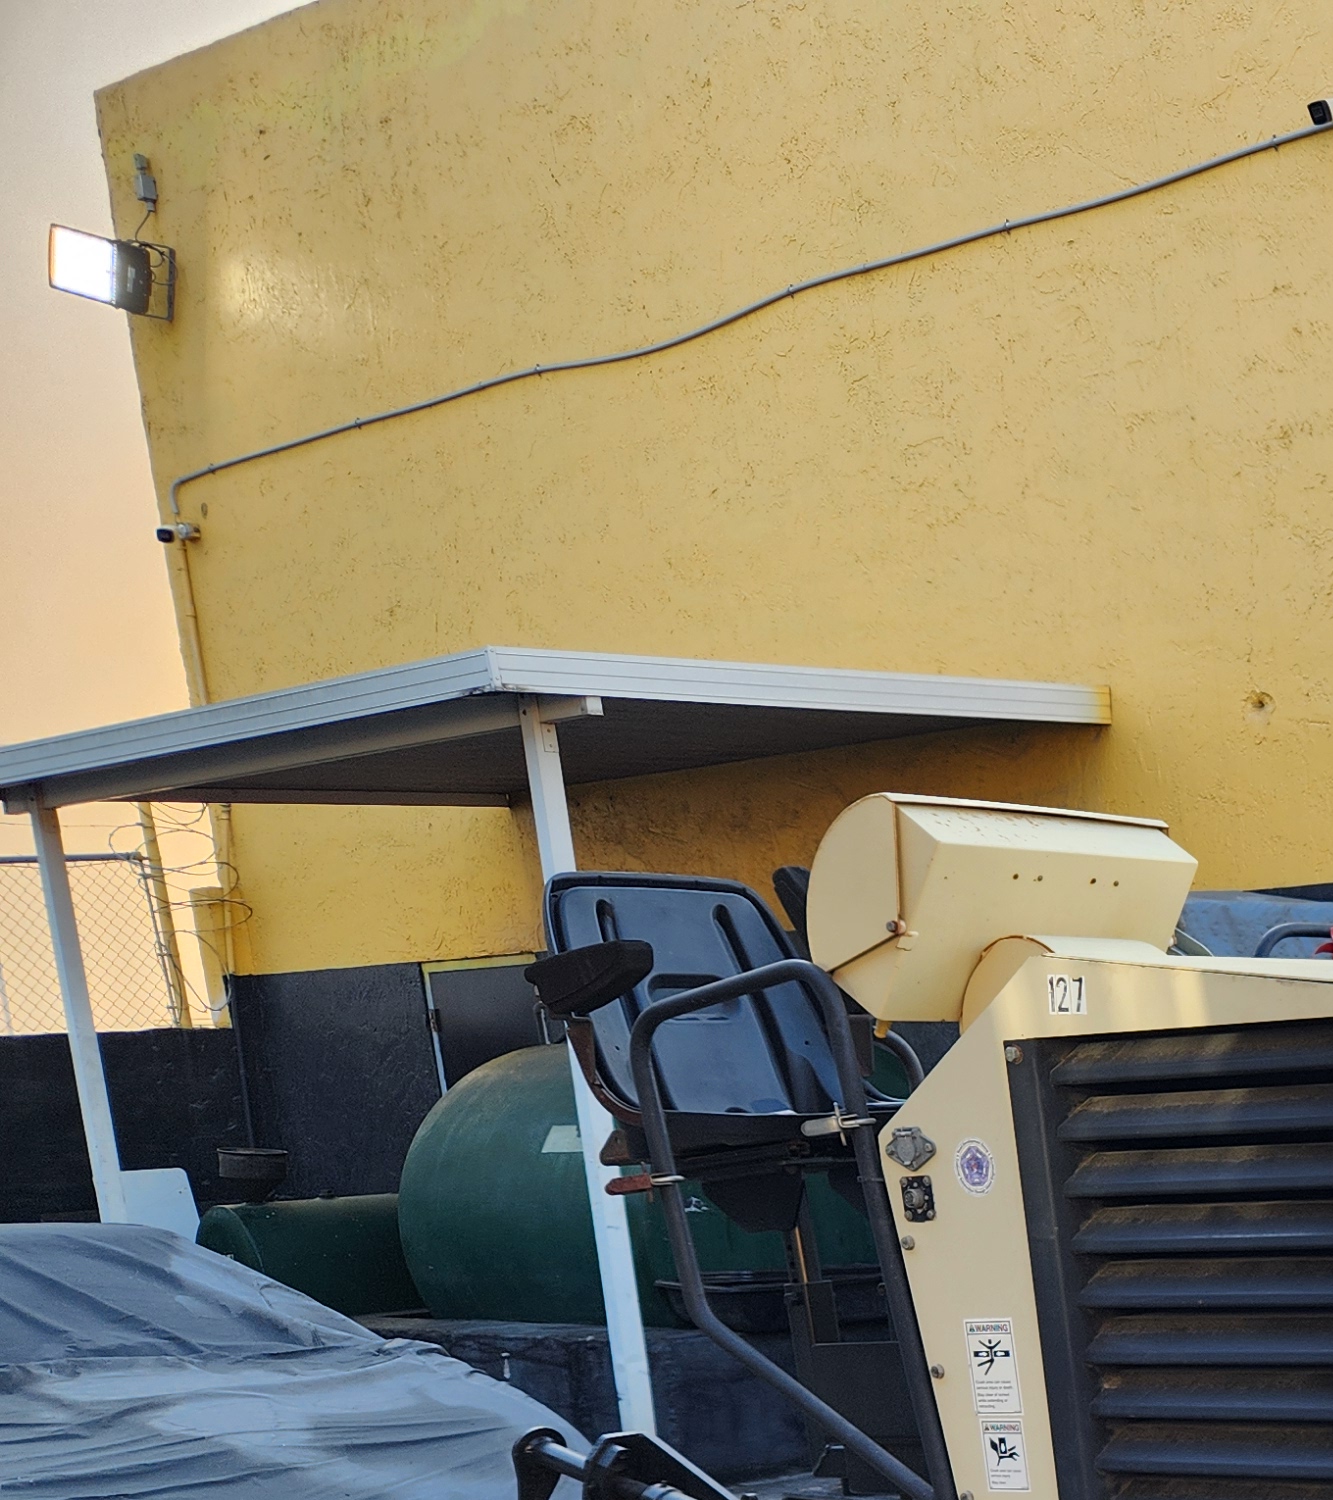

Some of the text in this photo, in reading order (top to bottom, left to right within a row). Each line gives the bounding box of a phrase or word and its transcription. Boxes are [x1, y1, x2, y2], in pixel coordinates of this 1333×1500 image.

[1048, 976, 1083, 1013] 127
[975, 1323, 1008, 1332] WARNING
[990, 1423, 1020, 1432] WARNING
